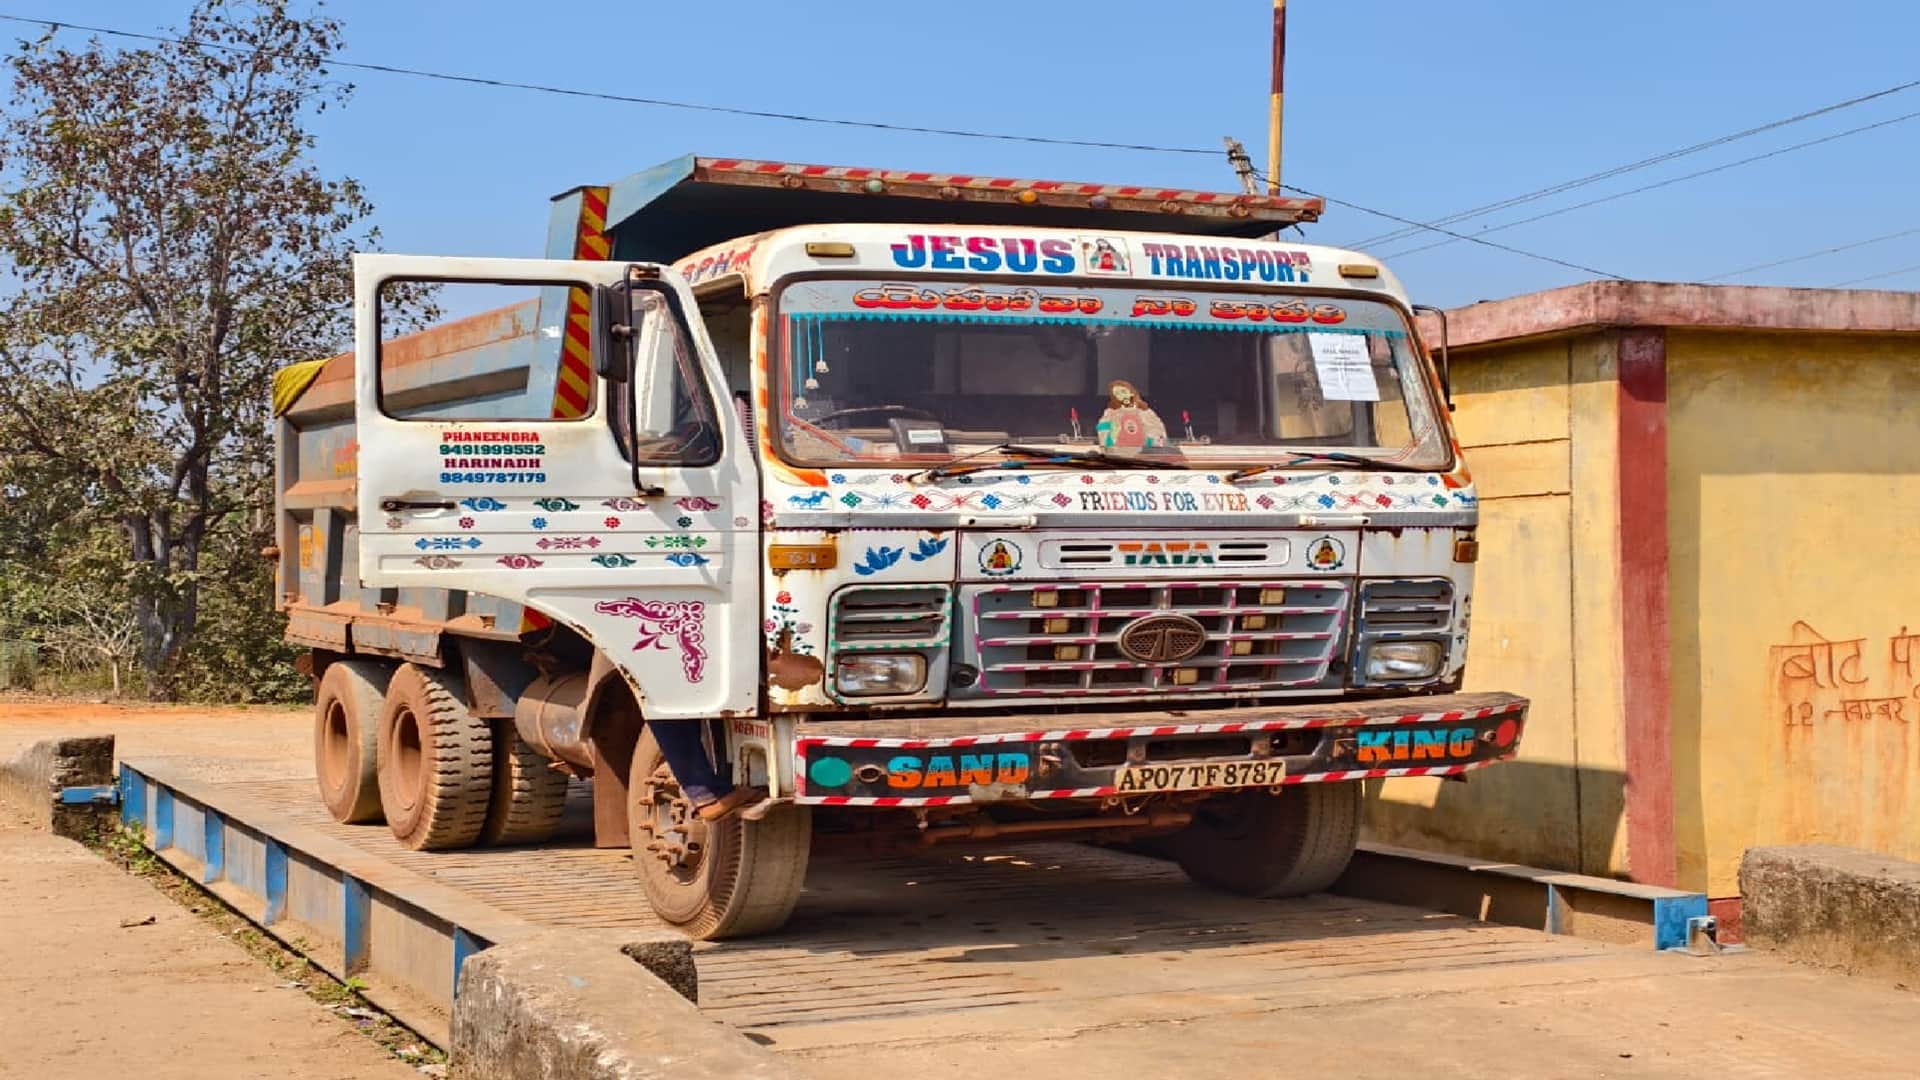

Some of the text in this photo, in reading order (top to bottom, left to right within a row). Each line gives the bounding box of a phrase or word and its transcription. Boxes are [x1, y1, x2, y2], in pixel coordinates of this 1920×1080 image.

[890, 234, 1312, 283] JESUS TRANSPORT
[442, 431, 540, 442] PHANEENDRA
[439, 444, 545, 455] 9491999552
[444, 458, 541, 469] HARINADH
[1078, 490, 1252, 512] FRIENDS FOR EVER
[1117, 541, 1216, 566] TATA
[1356, 728, 1475, 761] KING
[887, 752, 1029, 788] SAND
